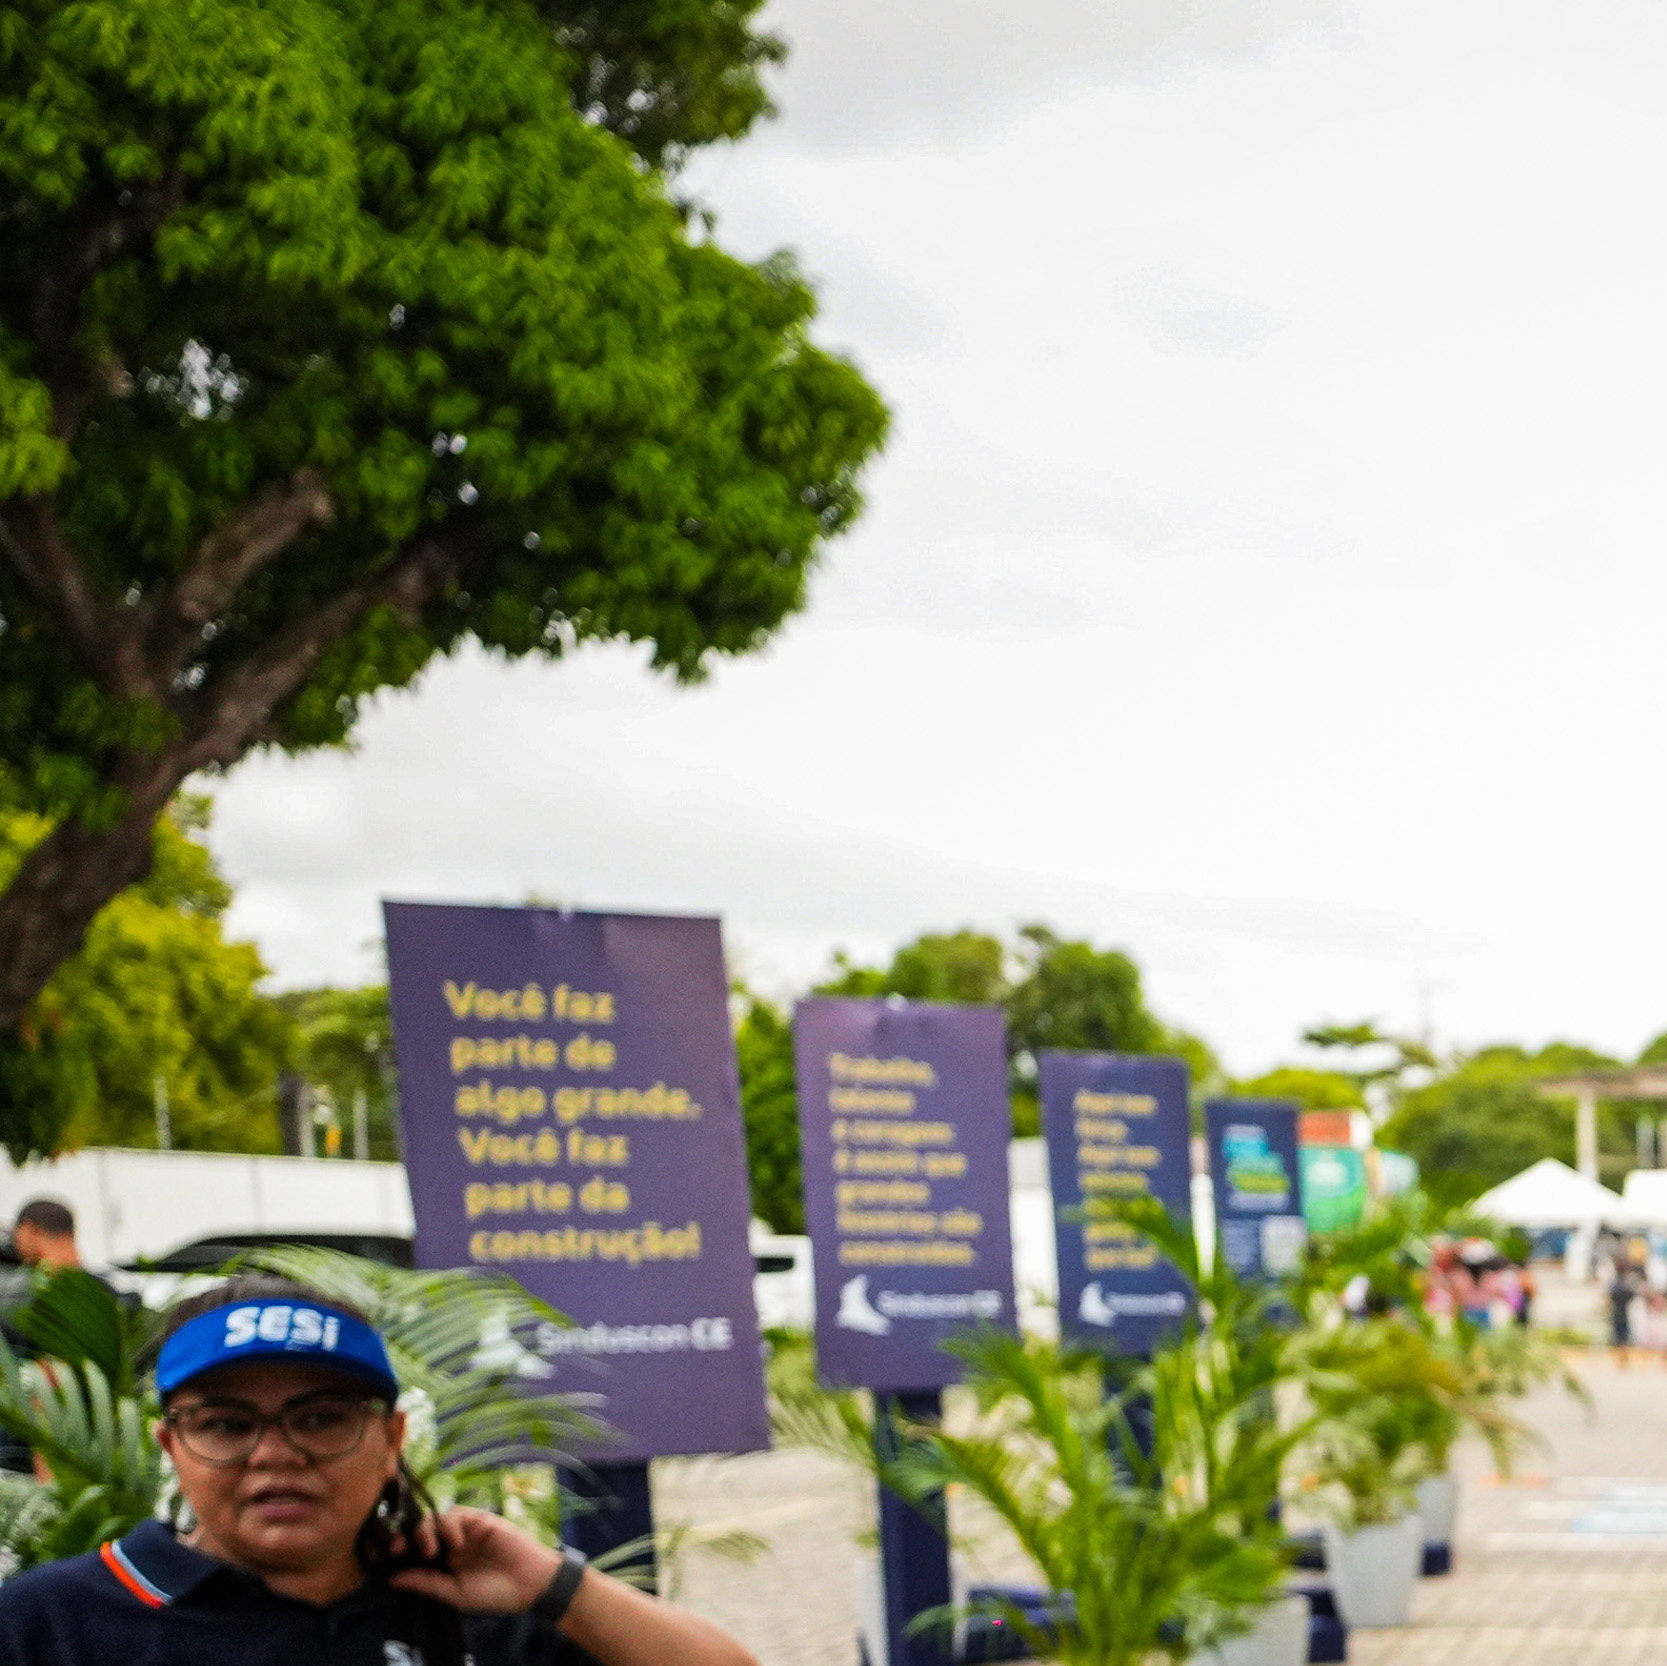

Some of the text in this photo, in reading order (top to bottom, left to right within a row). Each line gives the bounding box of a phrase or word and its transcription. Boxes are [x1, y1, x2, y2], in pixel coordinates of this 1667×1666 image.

[443, 980, 616, 1024] Você faz
[450, 1032, 616, 1075] parte de
[454, 1079, 702, 1126] algo grande.
[458, 1127, 629, 1167] Você faz
[465, 1175, 630, 1220] parte da
[469, 1221, 701, 1268] construção!
[225, 1305, 339, 1351] SESI
[537, 1317, 732, 1353] Sinduscon CE
